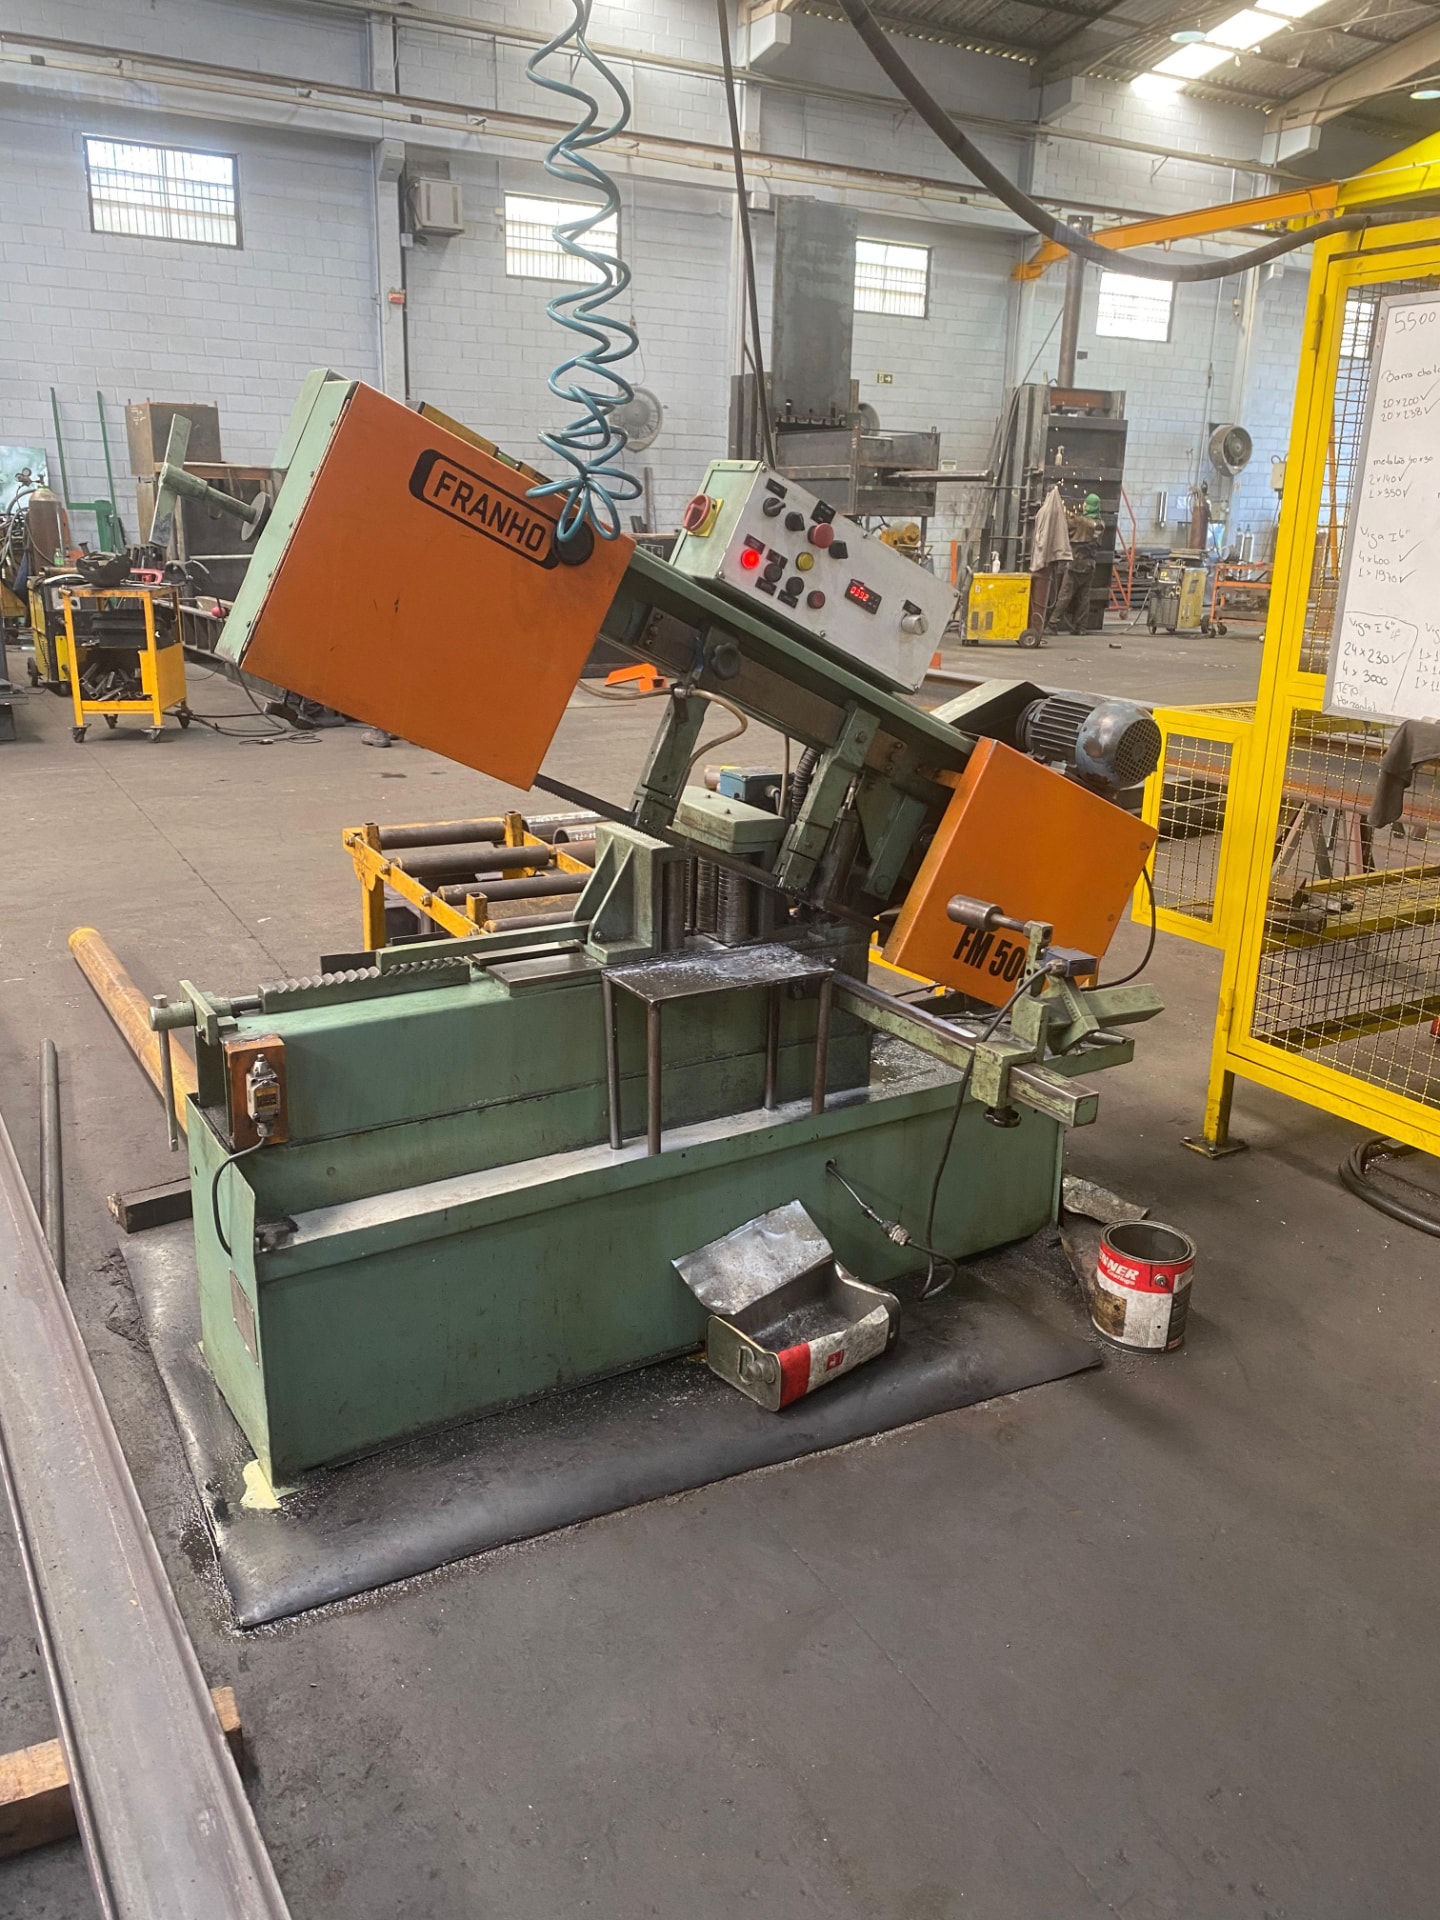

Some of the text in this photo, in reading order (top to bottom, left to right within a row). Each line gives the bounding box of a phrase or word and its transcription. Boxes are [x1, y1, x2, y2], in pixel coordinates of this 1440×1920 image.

[1394, 311, 1437, 334] 5500
[433, 469, 547, 552] FRANHO
[1367, 648, 1390, 664] 230
[952, 926, 1028, 982] FM 50
